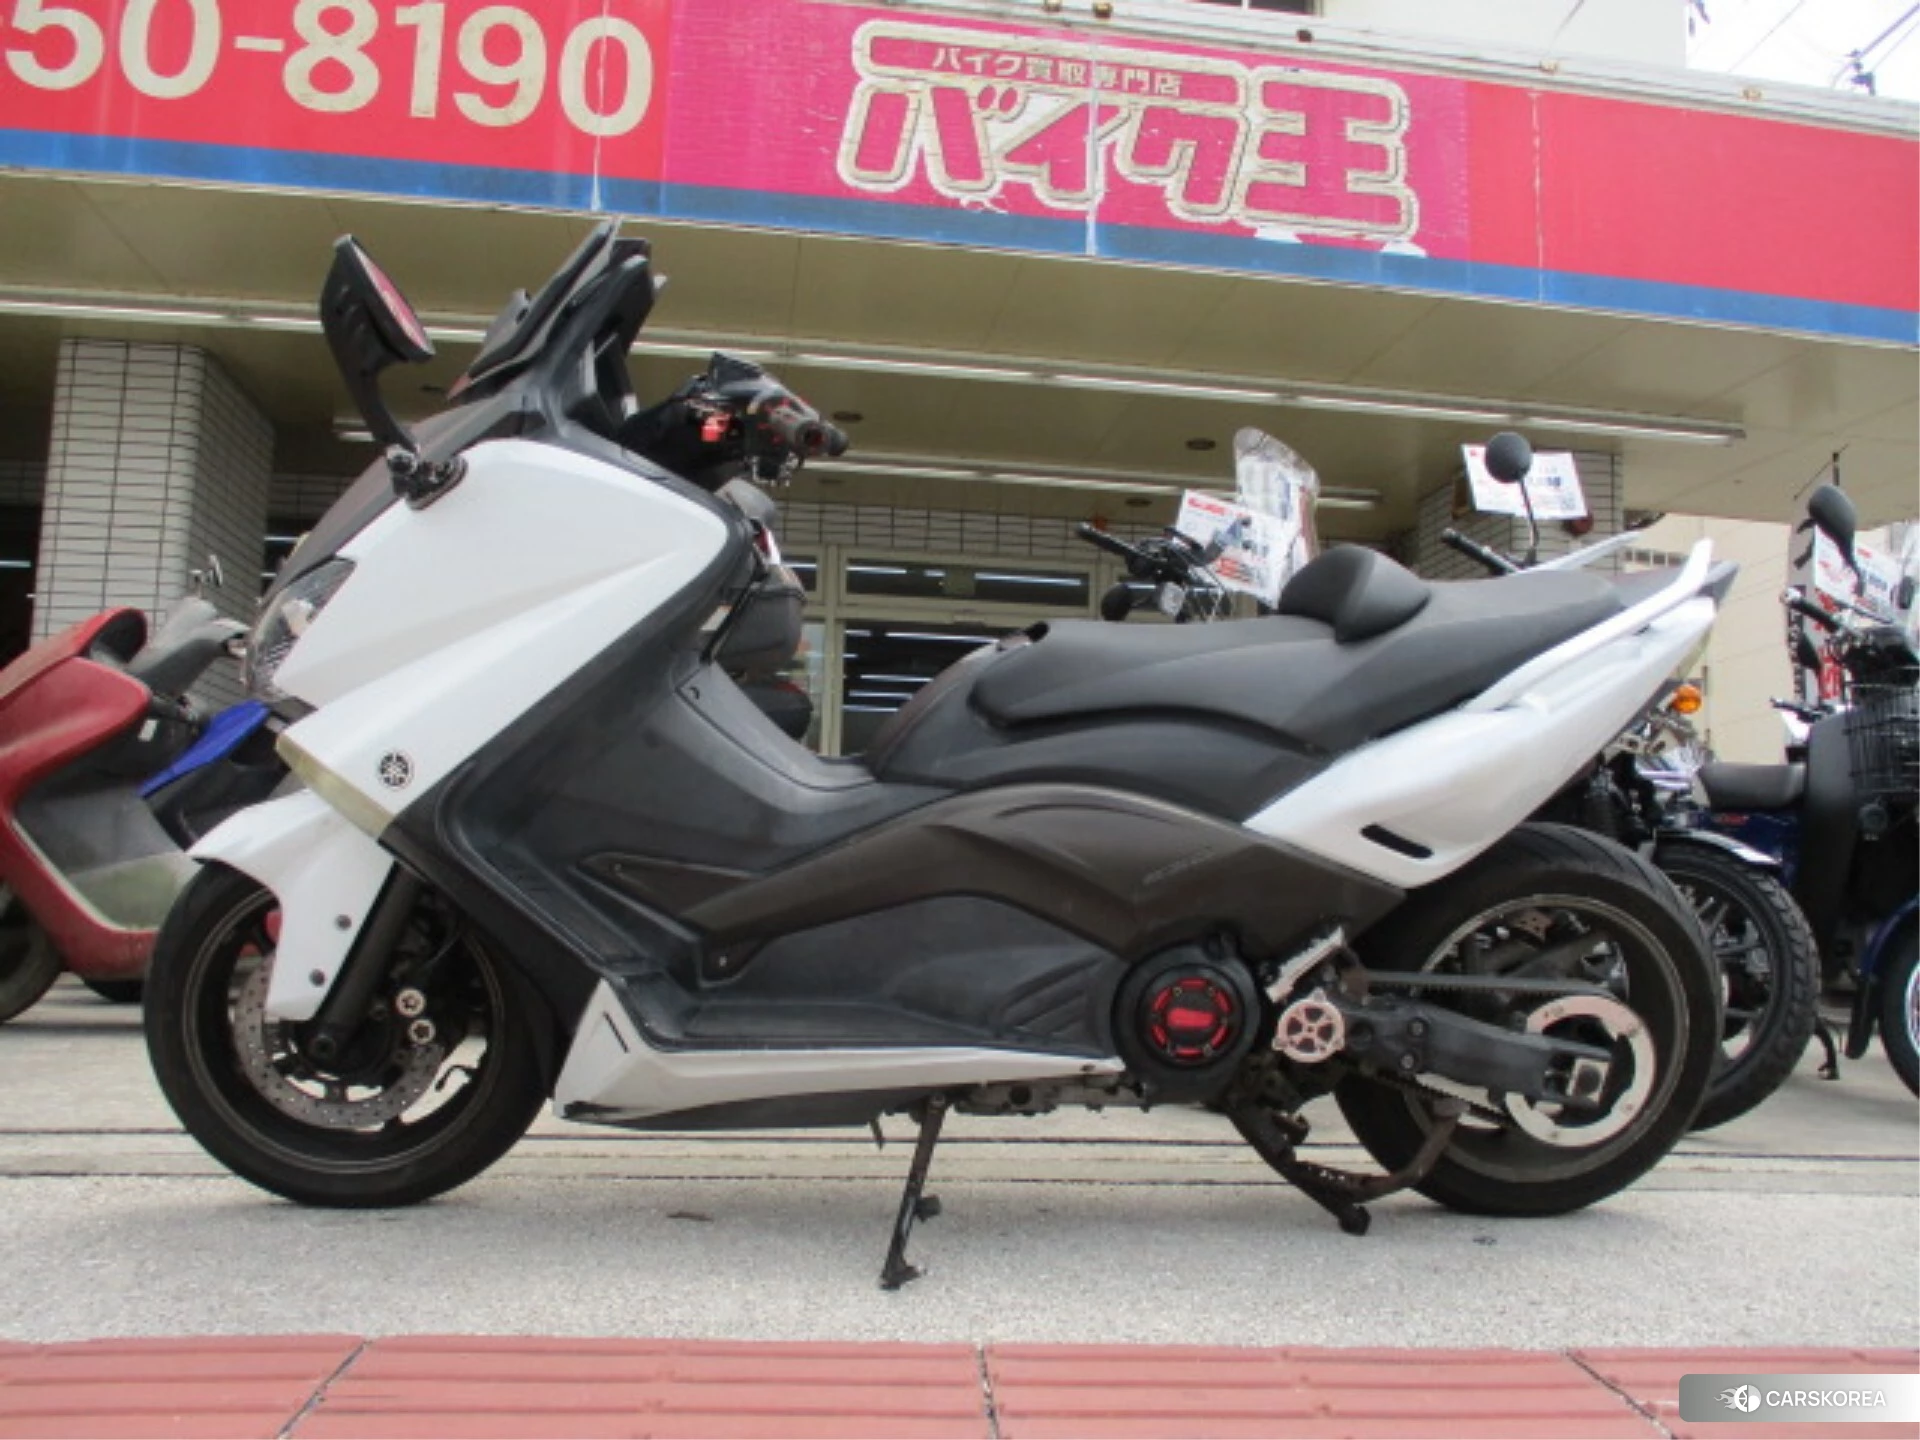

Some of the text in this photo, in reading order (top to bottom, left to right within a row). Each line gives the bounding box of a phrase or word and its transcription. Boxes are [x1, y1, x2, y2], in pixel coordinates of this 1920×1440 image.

[932, 47, 1182, 97] バイク買取専門店
[837, 78, 1420, 241] バイク王
